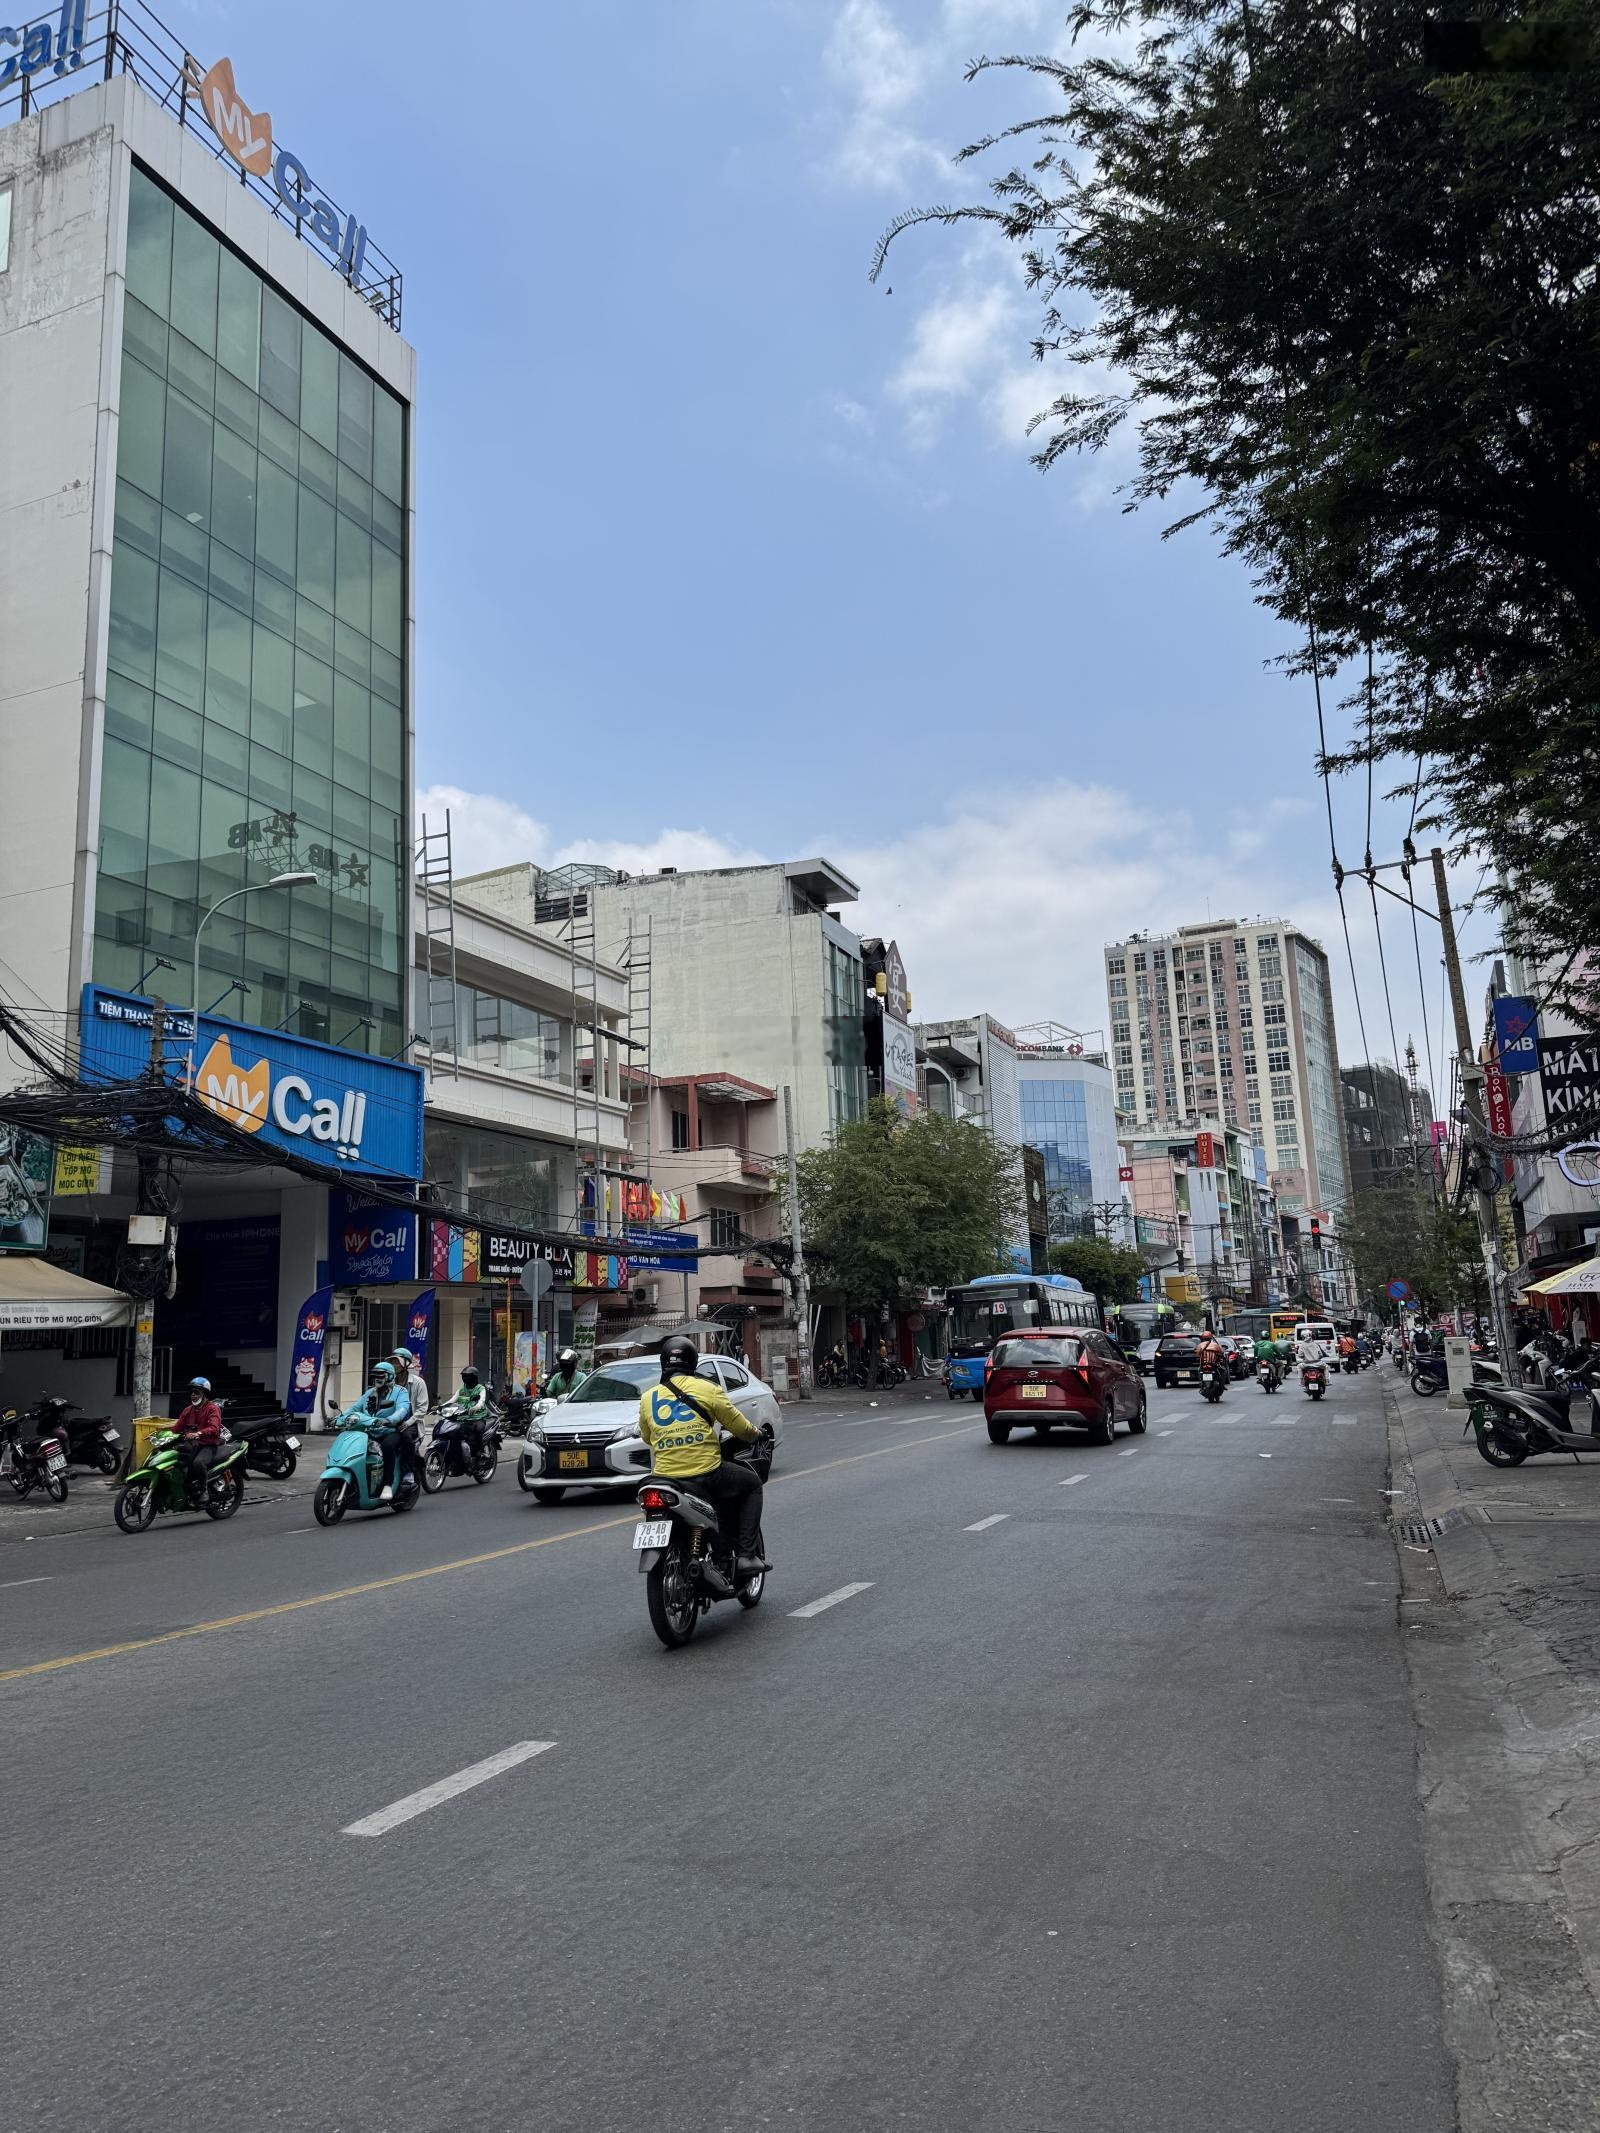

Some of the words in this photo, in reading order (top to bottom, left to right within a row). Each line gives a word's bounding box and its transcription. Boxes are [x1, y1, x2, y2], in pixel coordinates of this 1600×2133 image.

[212, 86, 268, 161] My
[99, 1001, 122, 1017] TIỆM
[1504, 1037, 1535, 1052] MB
[206, 1073, 265, 1131] My
[272, 1075, 367, 1161] Call
[344, 1232, 368, 1252] My
[370, 1226, 407, 1252] Call
[490, 1237, 540, 1259] BEAUTY
[994, 1303, 1004, 1313] 19
[307, 1318, 322, 1330] My
[414, 1317, 425, 1329] My
[300, 1328, 325, 1343] Call
[409, 1327, 428, 1340] Call
[652, 1390, 697, 1427] be
